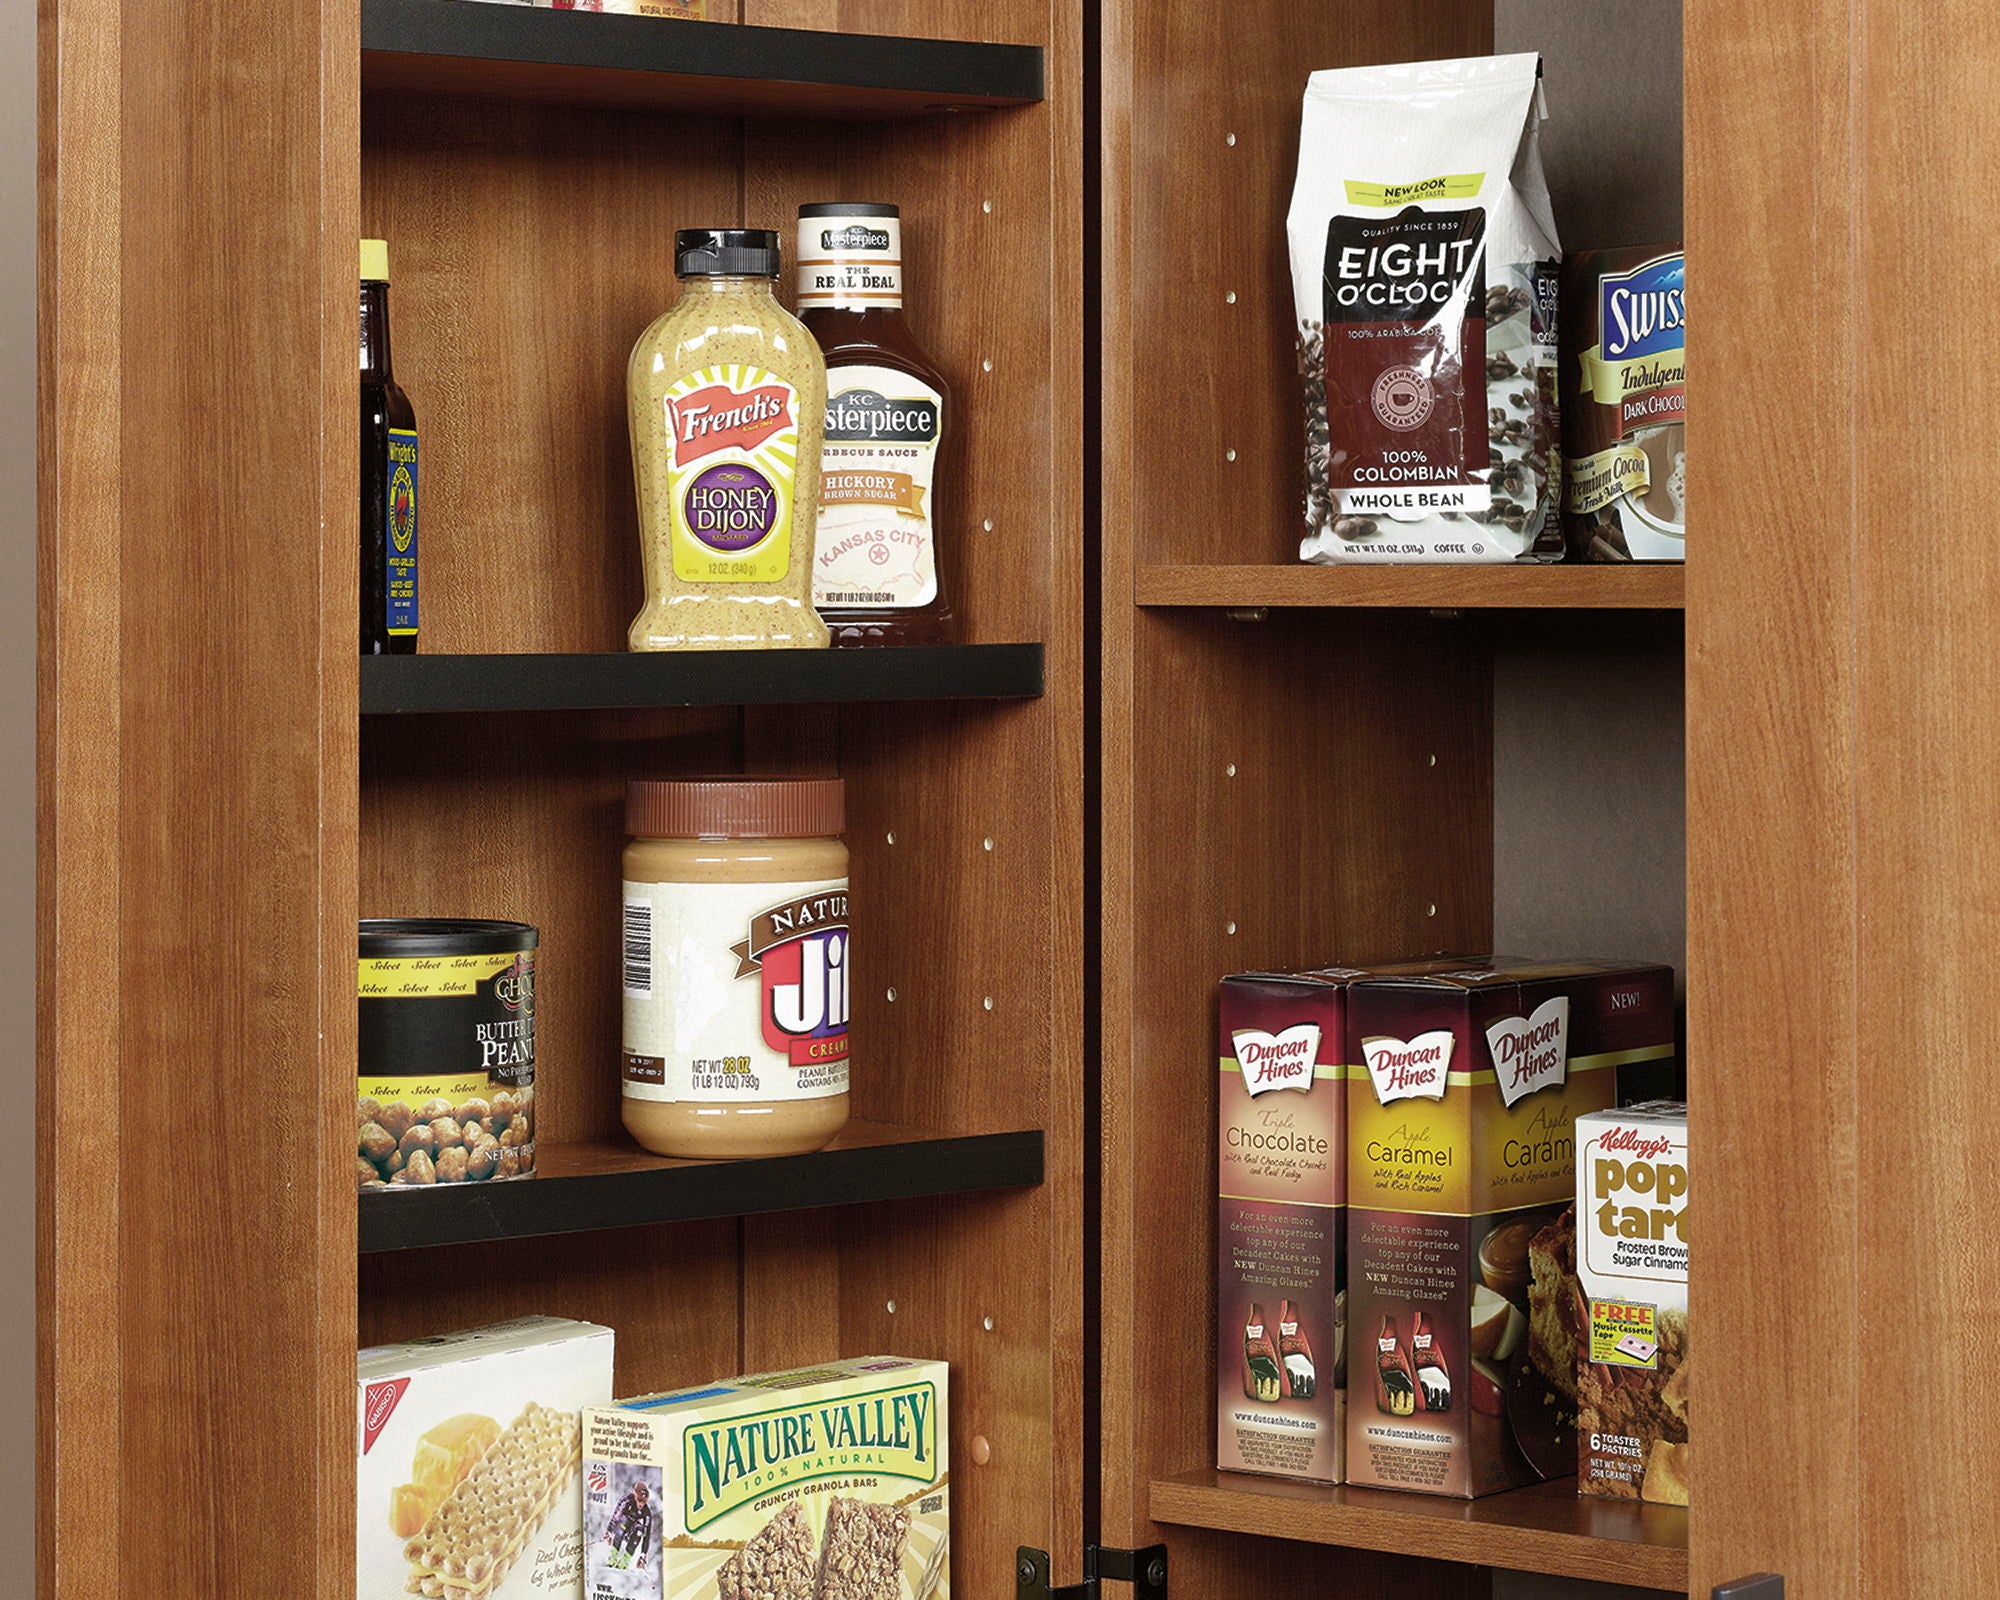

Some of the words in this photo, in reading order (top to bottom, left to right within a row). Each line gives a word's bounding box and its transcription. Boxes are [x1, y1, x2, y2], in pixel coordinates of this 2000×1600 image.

[1385, 187, 1412, 198] NEW
[1413, 178, 1446, 193] LOOK
[1362, 224, 1400, 238] QUALITY
[1403, 222, 1433, 232] SINCE
[1436, 221, 1459, 231] 1859
[823, 231, 888, 248] Masterpiece
[1338, 238, 1473, 280] EIGHT
[845, 267, 870, 275] THE
[815, 276, 857, 289] REAL
[861, 275, 895, 289] DEAL
[1609, 288, 1684, 355] SWIS
[1348, 330, 1374, 339] 100%
[1380, 371, 1426, 392] FRESHNESS
[849, 395, 873, 406] KC
[681, 392, 781, 443] French's
[1378, 400, 1429, 426] GUARANTEED
[1624, 401, 1647, 421] DARK
[825, 403, 931, 438] sterpiece
[389, 441, 417, 465] Wright's
[878, 449, 918, 458] SAUCE
[1382, 450, 1428, 464] 100%
[1353, 465, 1459, 483] COLOMBIAN
[1613, 456, 1645, 480] Cocoa
[826, 475, 896, 490] HICKORY
[692, 486, 775, 509] HONEY
[824, 489, 861, 500] BROWN
[864, 490, 897, 500] SUGAR
[1350, 494, 1413, 508] WHOLE
[1418, 492, 1465, 507] BEAN
[697, 509, 766, 534] DIJON
[820, 529, 886, 568] KANSAS
[889, 529, 926, 546] CITY
[1344, 544, 1360, 554] NET
[1433, 544, 1466, 554] COFFEE
[708, 563, 717, 574] 12
[770, 896, 848, 934] NATUR
[370, 960, 401, 970] Select
[411, 959, 441, 970] Select
[450, 958, 477, 968] Select
[485, 957, 507, 966] Select
[358, 983, 388, 993] Select
[398, 983, 428, 993] Select
[438, 982, 467, 992] Select
[1611, 991, 1640, 1010] NEW!
[1494, 1017, 1560, 1064] Duncan
[1240, 1039, 1308, 1064] Duncan
[1370, 1046, 1441, 1072] Duncan
[692, 1060, 707, 1073] NET
[708, 1060, 721, 1073] WT
[722, 1056, 736, 1075] 28
[737, 1056, 751, 1074] OZ
[799, 1067, 826, 1078] PEANUT
[1254, 1059, 1303, 1083] Hines
[1509, 1047, 1558, 1089] Hines
[692, 1075, 700, 1090] (1
[702, 1075, 712, 1089] LB
[714, 1075, 724, 1089] 12
[725, 1075, 739, 1090] OZ)
[741, 1074, 760, 1091] 793g
[1384, 1066, 1436, 1091] Hines
[370, 1086, 401, 1095] Select
[411, 1085, 441, 1095] Select
[450, 1083, 477, 1093] Select
[1257, 1109, 1295, 1135] Triple
[1527, 1105, 1570, 1141] Apple
[1226, 1127, 1328, 1154] Chocolate
[1387, 1123, 1432, 1149] Apple
[1600, 1127, 1671, 1159] Kellogg's
[1367, 1141, 1452, 1166] Caramel
[1504, 1138, 1575, 1168] Caram
[1260, 1155, 1297, 1168] Chocolate
[1300, 1160, 1327, 1171] Chunks
[1249, 1166, 1262, 1175] and
[1281, 1168, 1302, 1183] Fudge
[1373, 1168, 1393, 1179] with
[1395, 1168, 1412, 1180] Real
[1414, 1169, 1442, 1183] Apples
[1595, 1158, 1687, 1205] pop
[1375, 1180, 1388, 1189] and
[1391, 1180, 1410, 1191] Rich
[1411, 1181, 1444, 1193] Caramel
[1239, 1210, 1254, 1220] For
[1269, 1215, 1289, 1224] even
[1291, 1217, 1314, 1226] more
[1230, 1221, 1273, 1235] delectable
[1275, 1229, 1324, 1240] experience
[1371, 1222, 1386, 1232] For
[1388, 1225, 1399, 1233] an
[1401, 1226, 1422, 1236] even
[1424, 1228, 1449, 1238] more
[1247, 1236, 1260, 1248] top
[1262, 1240, 1277, 1250] any
[1290, 1242, 1306, 1251] our
[1361, 1233, 1406, 1246] delectable
[1408, 1240, 1460, 1252] experience
[1617, 1241, 1657, 1256] Frosted
[1233, 1247, 1271, 1259] Decadent
[1273, 1250, 1299, 1262] Cakes
[1301, 1254, 1321, 1265] with
[1378, 1248, 1392, 1260] top
[1394, 1251, 1410, 1262] any
[1412, 1252, 1423, 1260] of
[1612, 1253, 1641, 1267] Sugar
[1234, 1259, 1257, 1270] NEW
[1258, 1262, 1291, 1275] Duncan
[1293, 1265, 1320, 1277] Hines
[1364, 1258, 1404, 1271] Decadent
[1406, 1263, 1434, 1274] Cakes
[1435, 1266, 1457, 1276] with
[1241, 1273, 1278, 1288] Amazing
[1366, 1272, 1389, 1282] NEW
[1391, 1275, 1425, 1286] Duncan
[1427, 1278, 1455, 1288] Hines
[1373, 1286, 1411, 1301] Amazing
[1594, 1303, 1652, 1325] FREE
[1594, 1322, 1617, 1332] Music
[1618, 1324, 1653, 1335] Cassette
[1594, 1329, 1614, 1340] Tape
[368, 1387, 394, 1428] NABISCO
[1235, 1413, 1317, 1430] www.duncanhines.com
[1367, 1427, 1452, 1444] www.duncanhines.com
[1590, 1434, 1601, 1451] 6
[1602, 1434, 1641, 1447] TOASTER
[691, 1413, 816, 1513] NATURE
[820, 1390, 930, 1462] VALLEY
[1602, 1444, 1642, 1458] PASTRIES
[744, 1466, 789, 1491] 100%
[802, 1453, 885, 1471] NATURAL
[1590, 1458, 1603, 1468] NET
[753, 1487, 801, 1512] CRUNCHY
[803, 1478, 850, 1496] GRANOLA
[852, 1477, 878, 1488] BARS
[535, 1546, 558, 1566] Real
[546, 1560, 573, 1579] Whole
